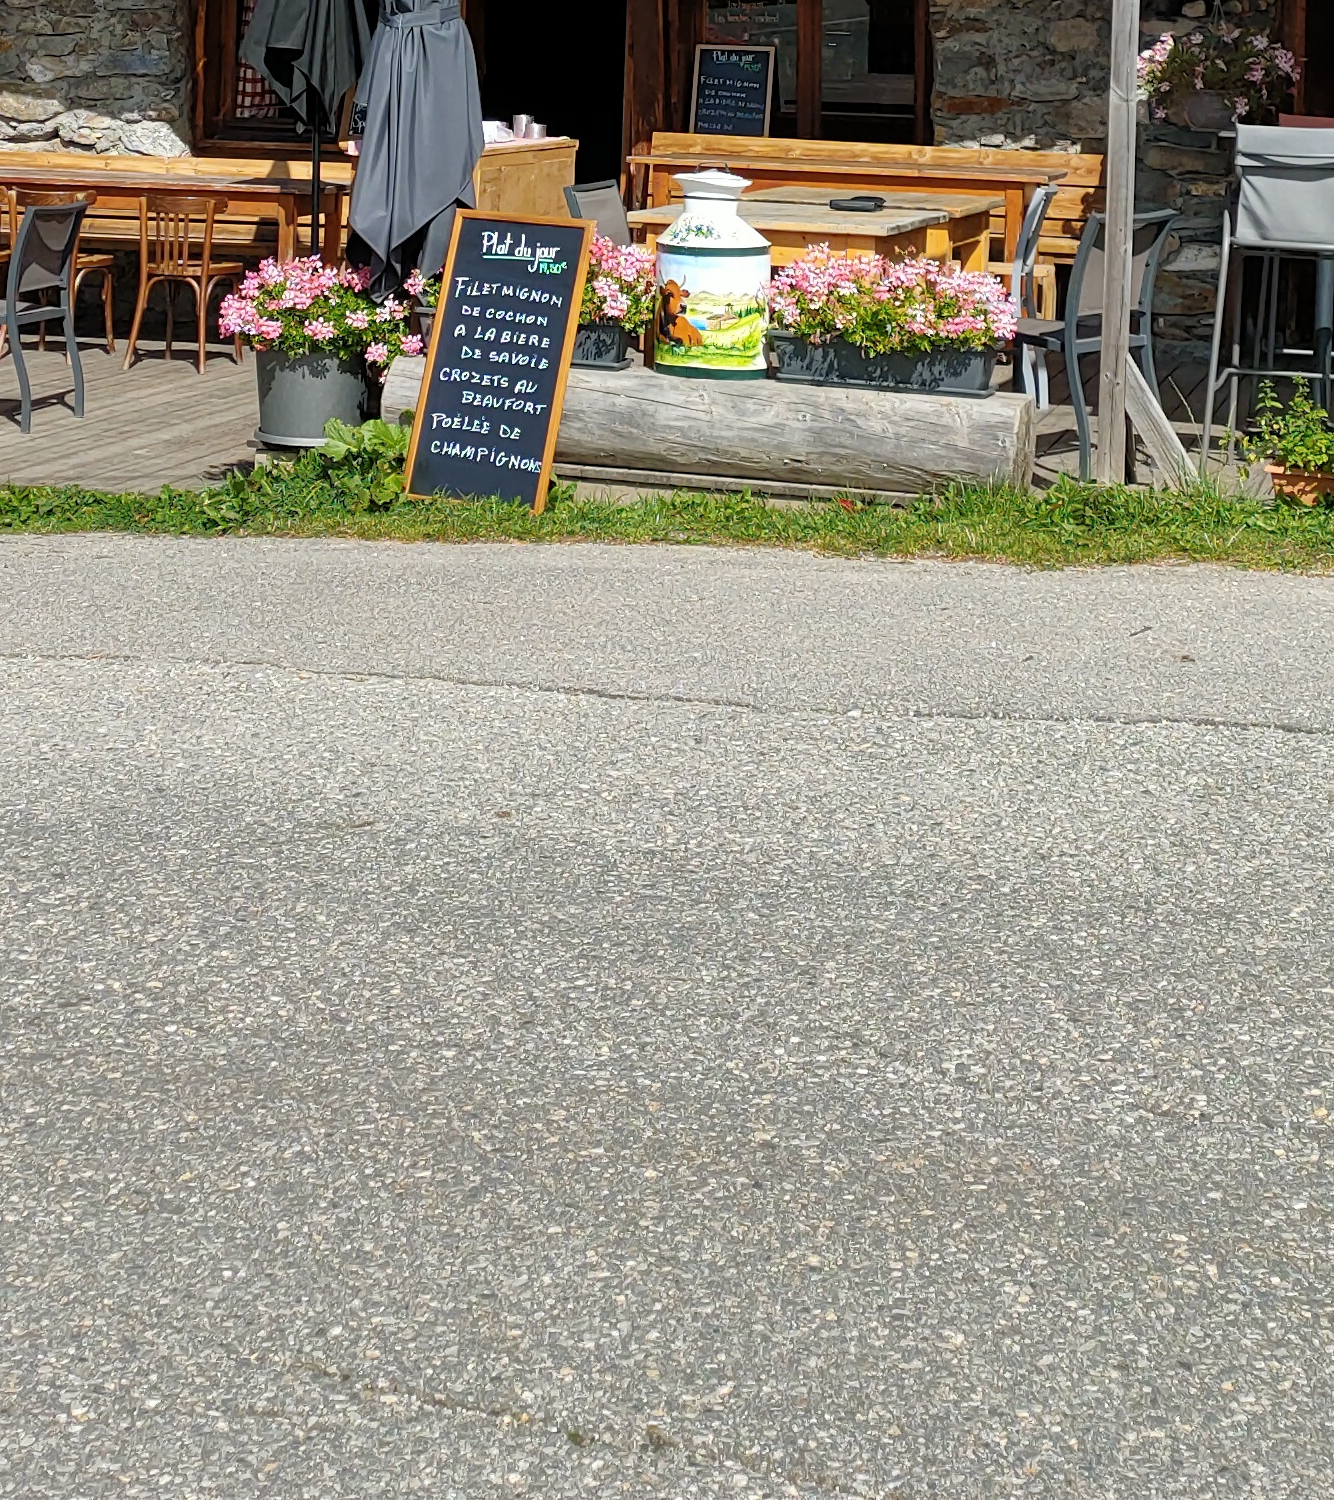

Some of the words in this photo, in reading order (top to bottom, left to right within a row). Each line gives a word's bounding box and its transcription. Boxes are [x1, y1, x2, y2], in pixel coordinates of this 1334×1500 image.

[730, 53, 739, 61] du
[739, 53, 755, 67] jour
[481, 231, 513, 255] Plat
[515, 233, 532, 257] du
[527, 242, 560, 273] jour
[461, 305, 481, 317] DE
[485, 308, 548, 327] COCHON
[454, 324, 466, 338] A
[474, 326, 496, 342] LA
[500, 330, 551, 349] BIERE
[461, 345, 482, 360] DE
[488, 351, 549, 370] SAVOIE
[439, 367, 509, 388] CROZETS
[514, 380, 538, 394] AU
[461, 390, 547, 415] BEAUFORT
[499, 424, 521, 440] DE
[430, 440, 542, 474] CHAMPIGNONS
